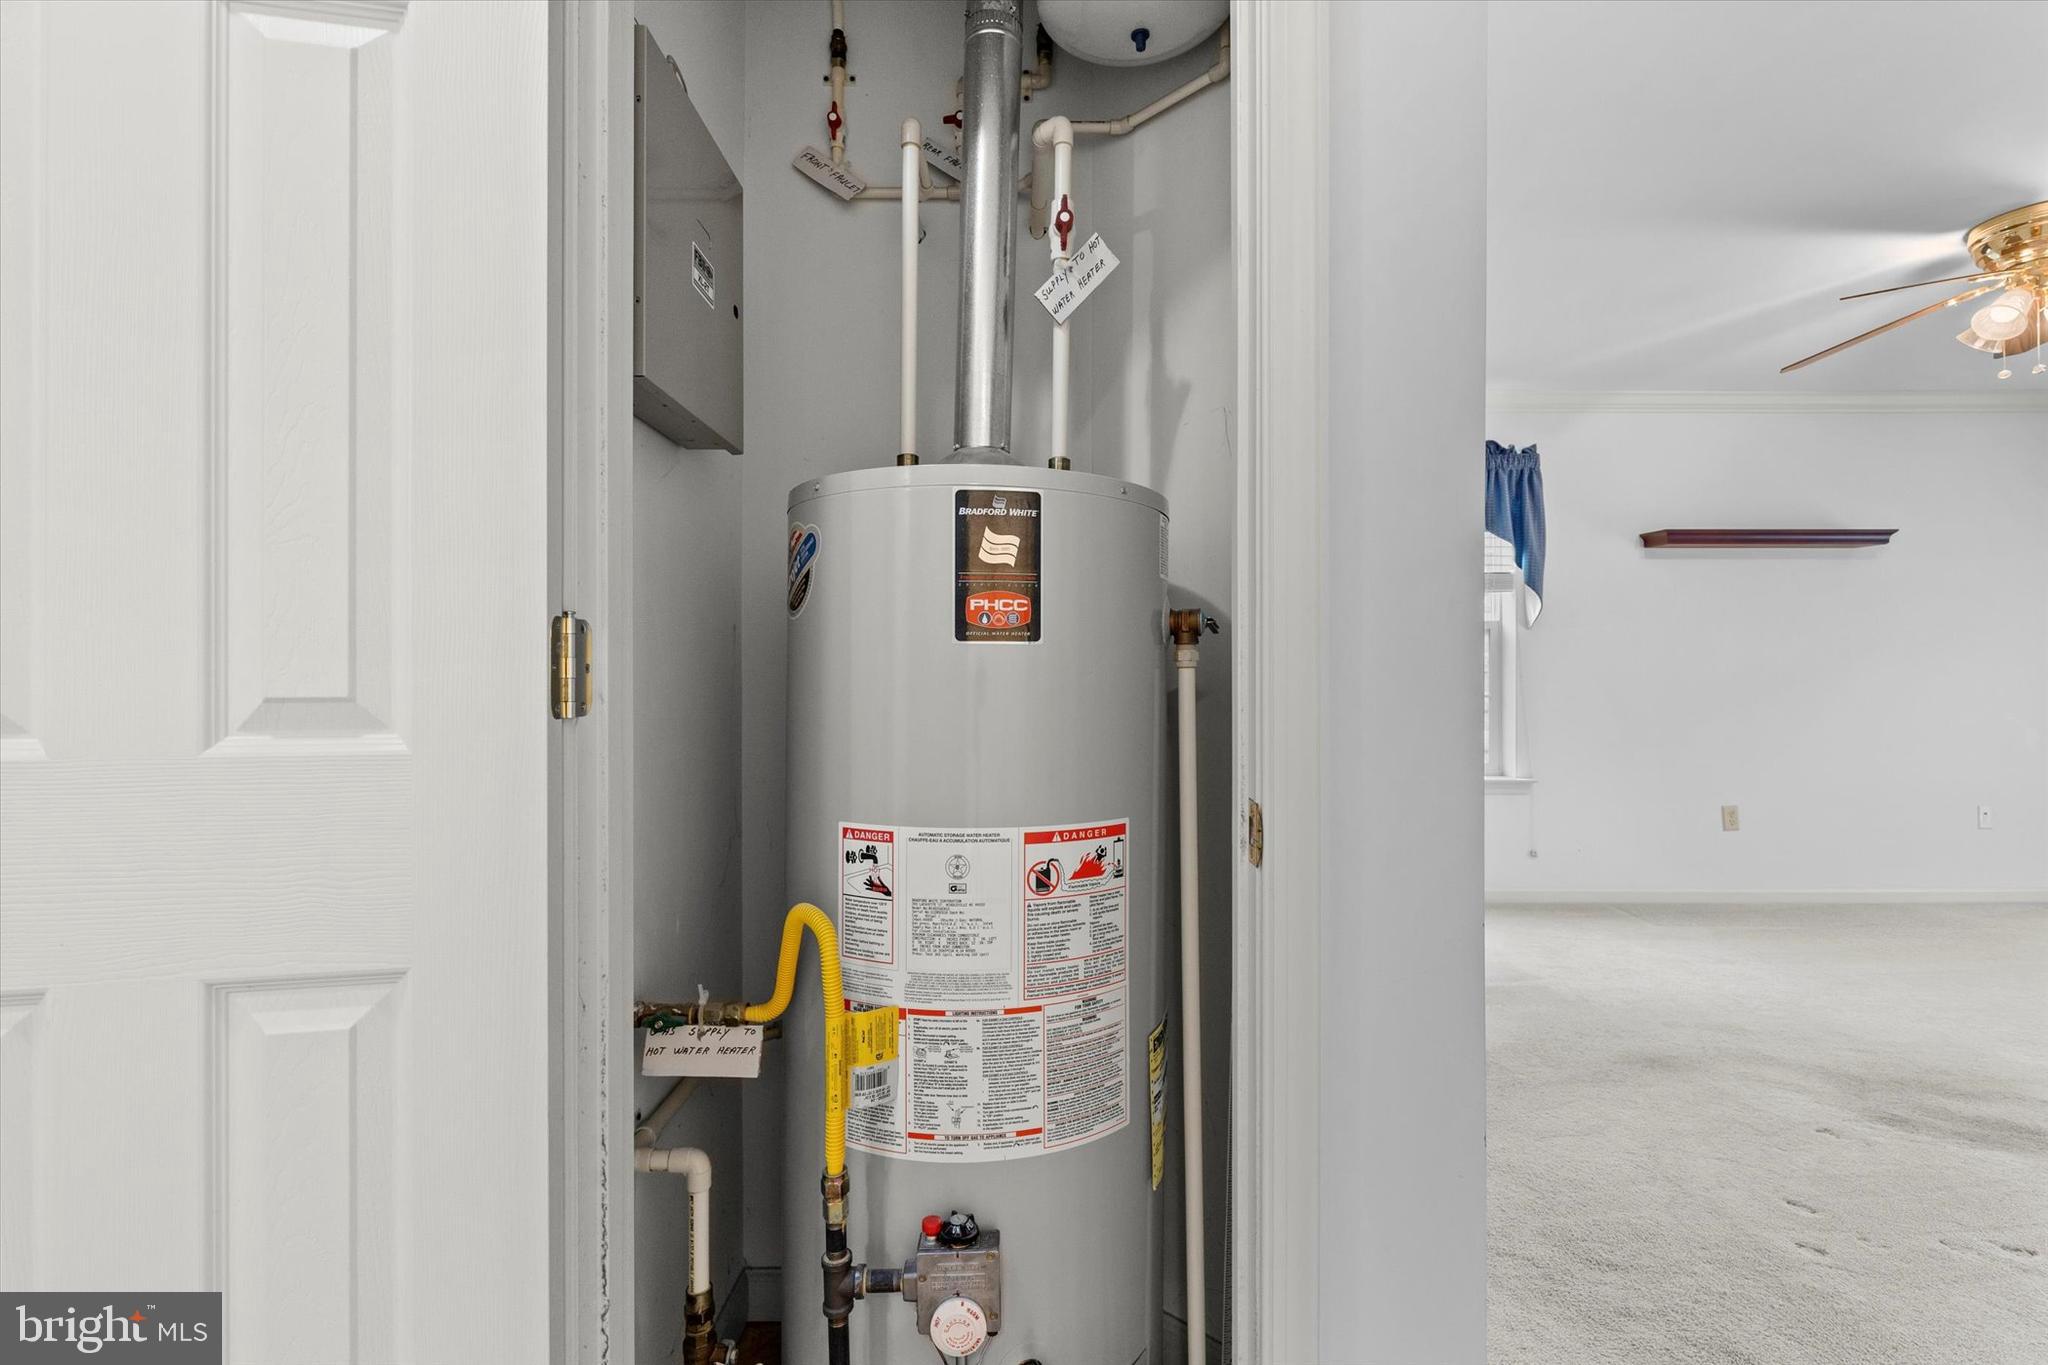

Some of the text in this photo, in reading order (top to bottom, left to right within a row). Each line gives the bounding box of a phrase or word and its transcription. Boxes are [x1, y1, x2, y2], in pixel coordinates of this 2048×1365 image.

[922, 141, 962, 169] REAR FAU
[800, 151, 861, 194] FRONT FAUCET
[1072, 252, 1085, 266] TO
[1088, 234, 1101, 254] HOT
[1051, 258, 1107, 315] WATER HEATER
[958, 507, 1039, 518] BRADFORD WHITE
[969, 598, 1029, 612] PHCC
[853, 830, 891, 842] DANGER
[1062, 827, 1108, 841] DANGER
[744, 1027, 757, 1036] TO
[645, 1045, 757, 1057] HOT WATER HEATER
